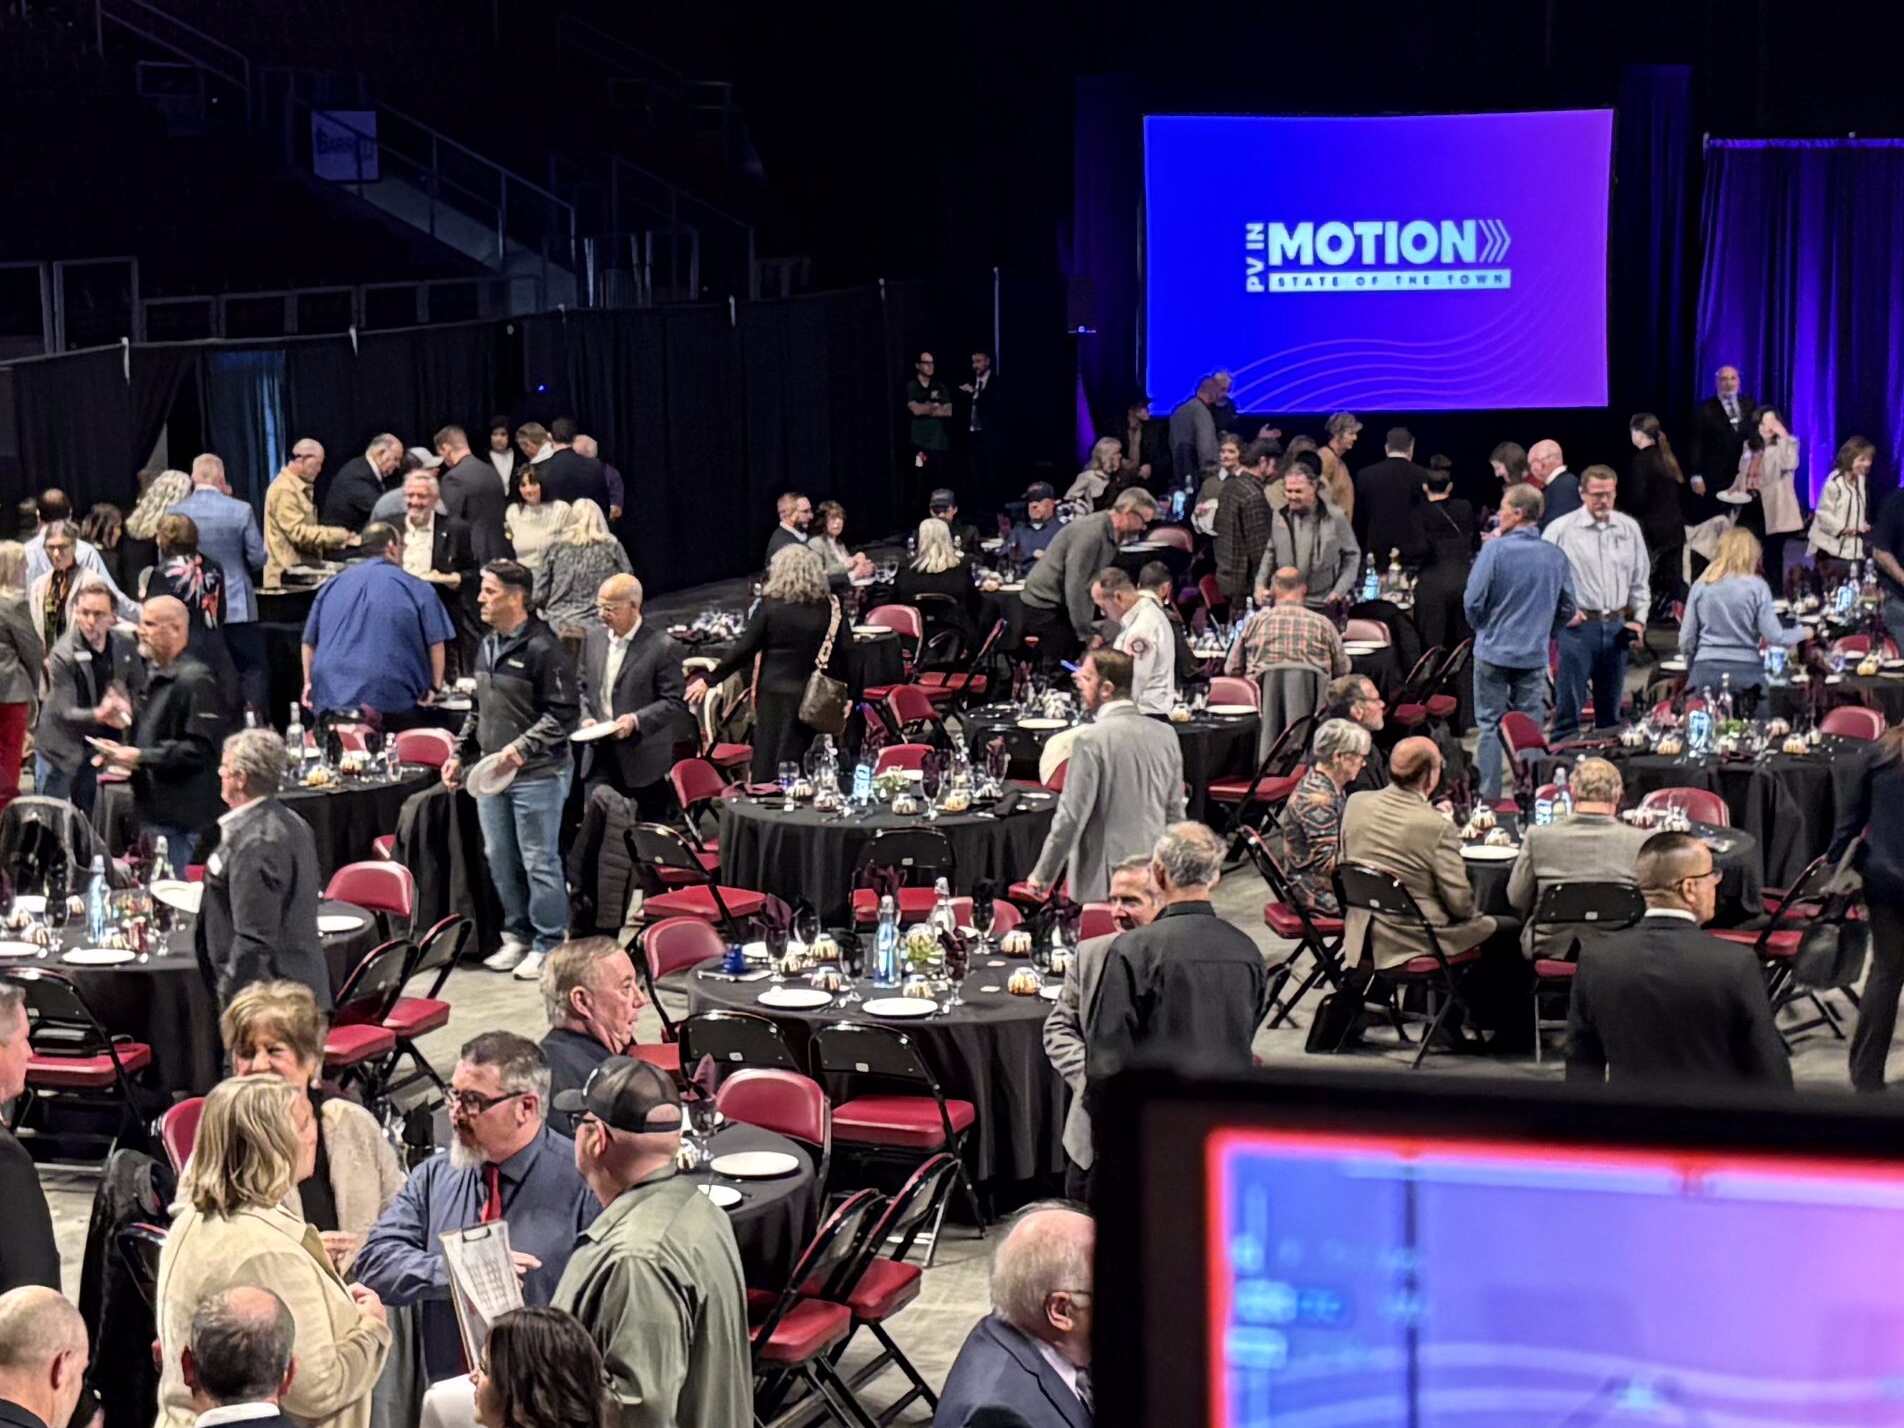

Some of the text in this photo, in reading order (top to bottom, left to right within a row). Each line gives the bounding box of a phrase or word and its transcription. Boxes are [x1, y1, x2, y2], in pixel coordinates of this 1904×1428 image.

[1246, 222, 1265, 293] PV IN
[1268, 219, 1477, 265] MOTION
[1278, 273, 1504, 287] STATE OF THE TOWN
